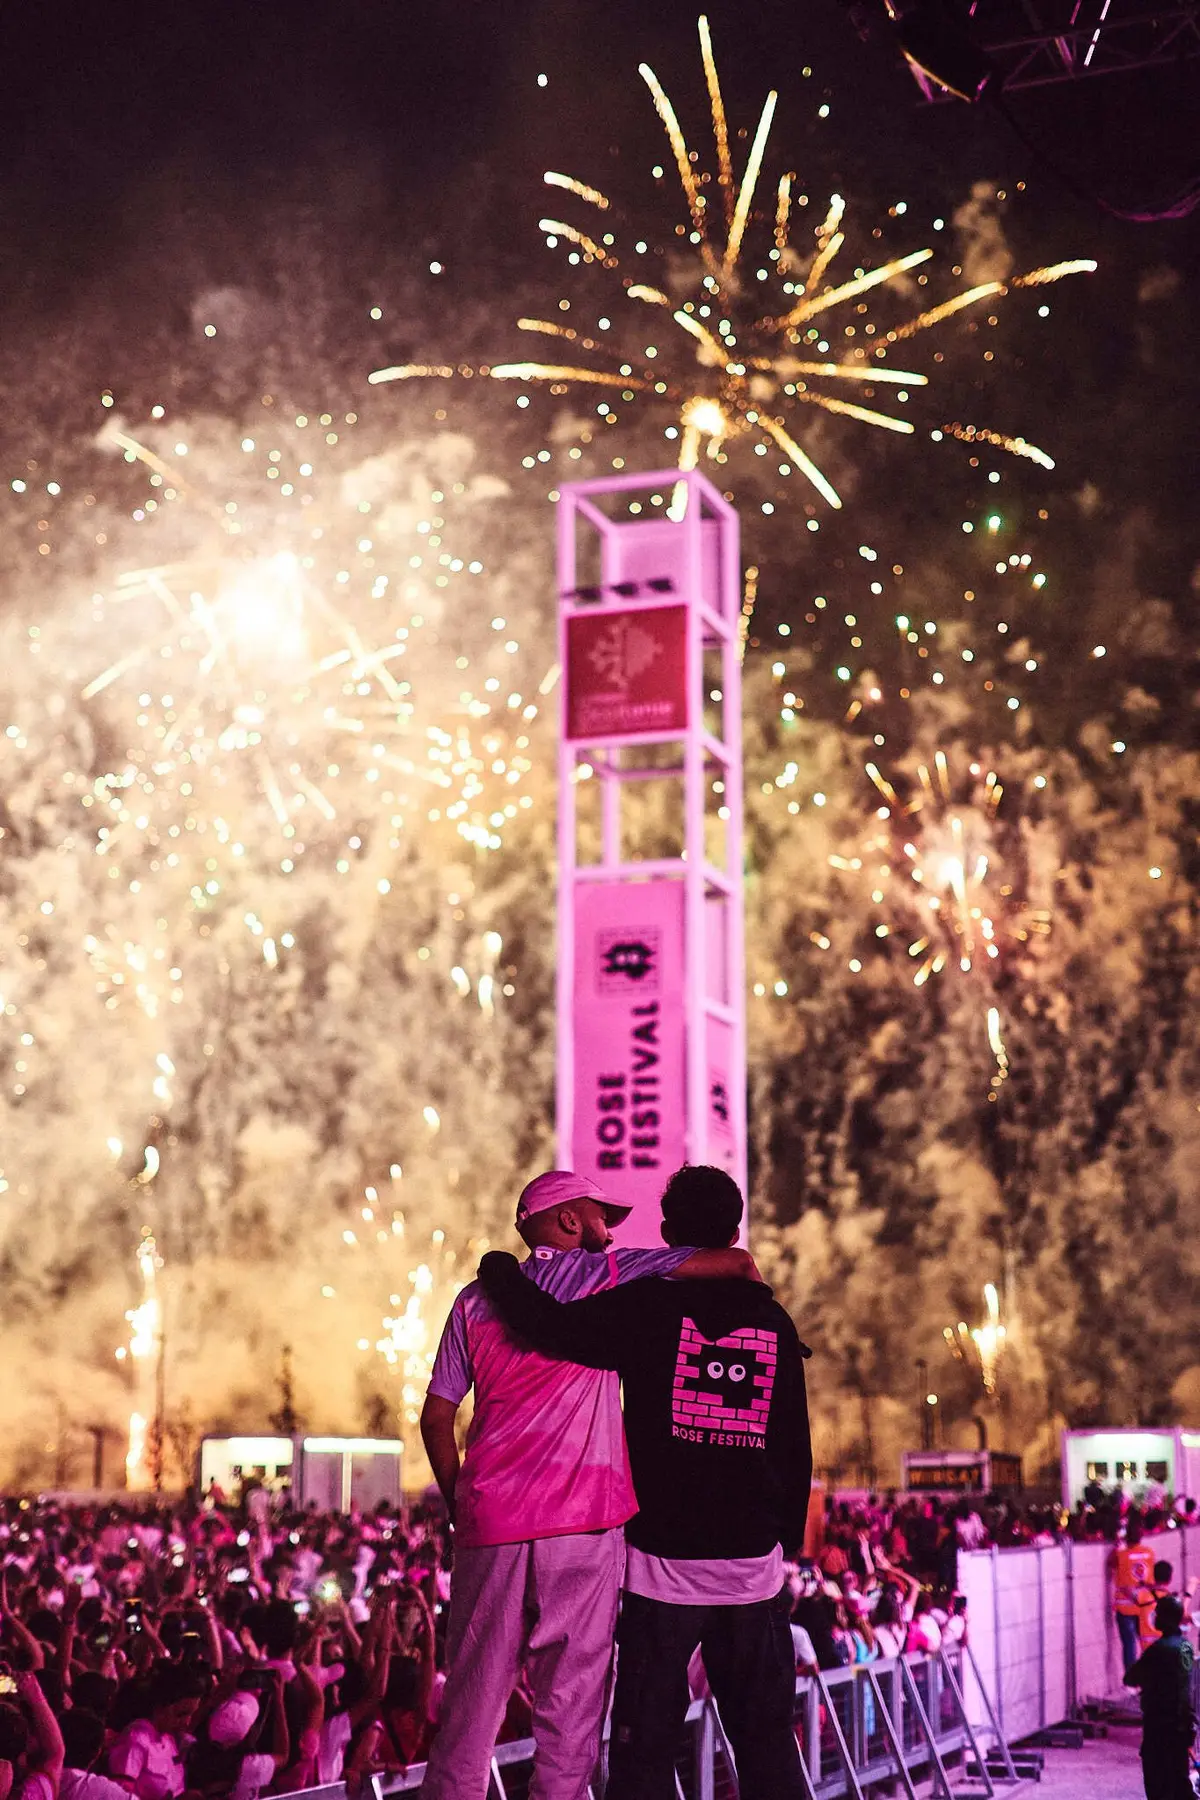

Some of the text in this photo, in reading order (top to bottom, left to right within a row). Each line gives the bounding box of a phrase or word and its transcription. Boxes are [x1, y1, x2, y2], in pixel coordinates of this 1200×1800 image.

[597, 1074, 625, 1169] ROSE
[632, 1001, 659, 1168] FESTIVAL
[672, 1425, 766, 1450] ROSE FESTIVAL
